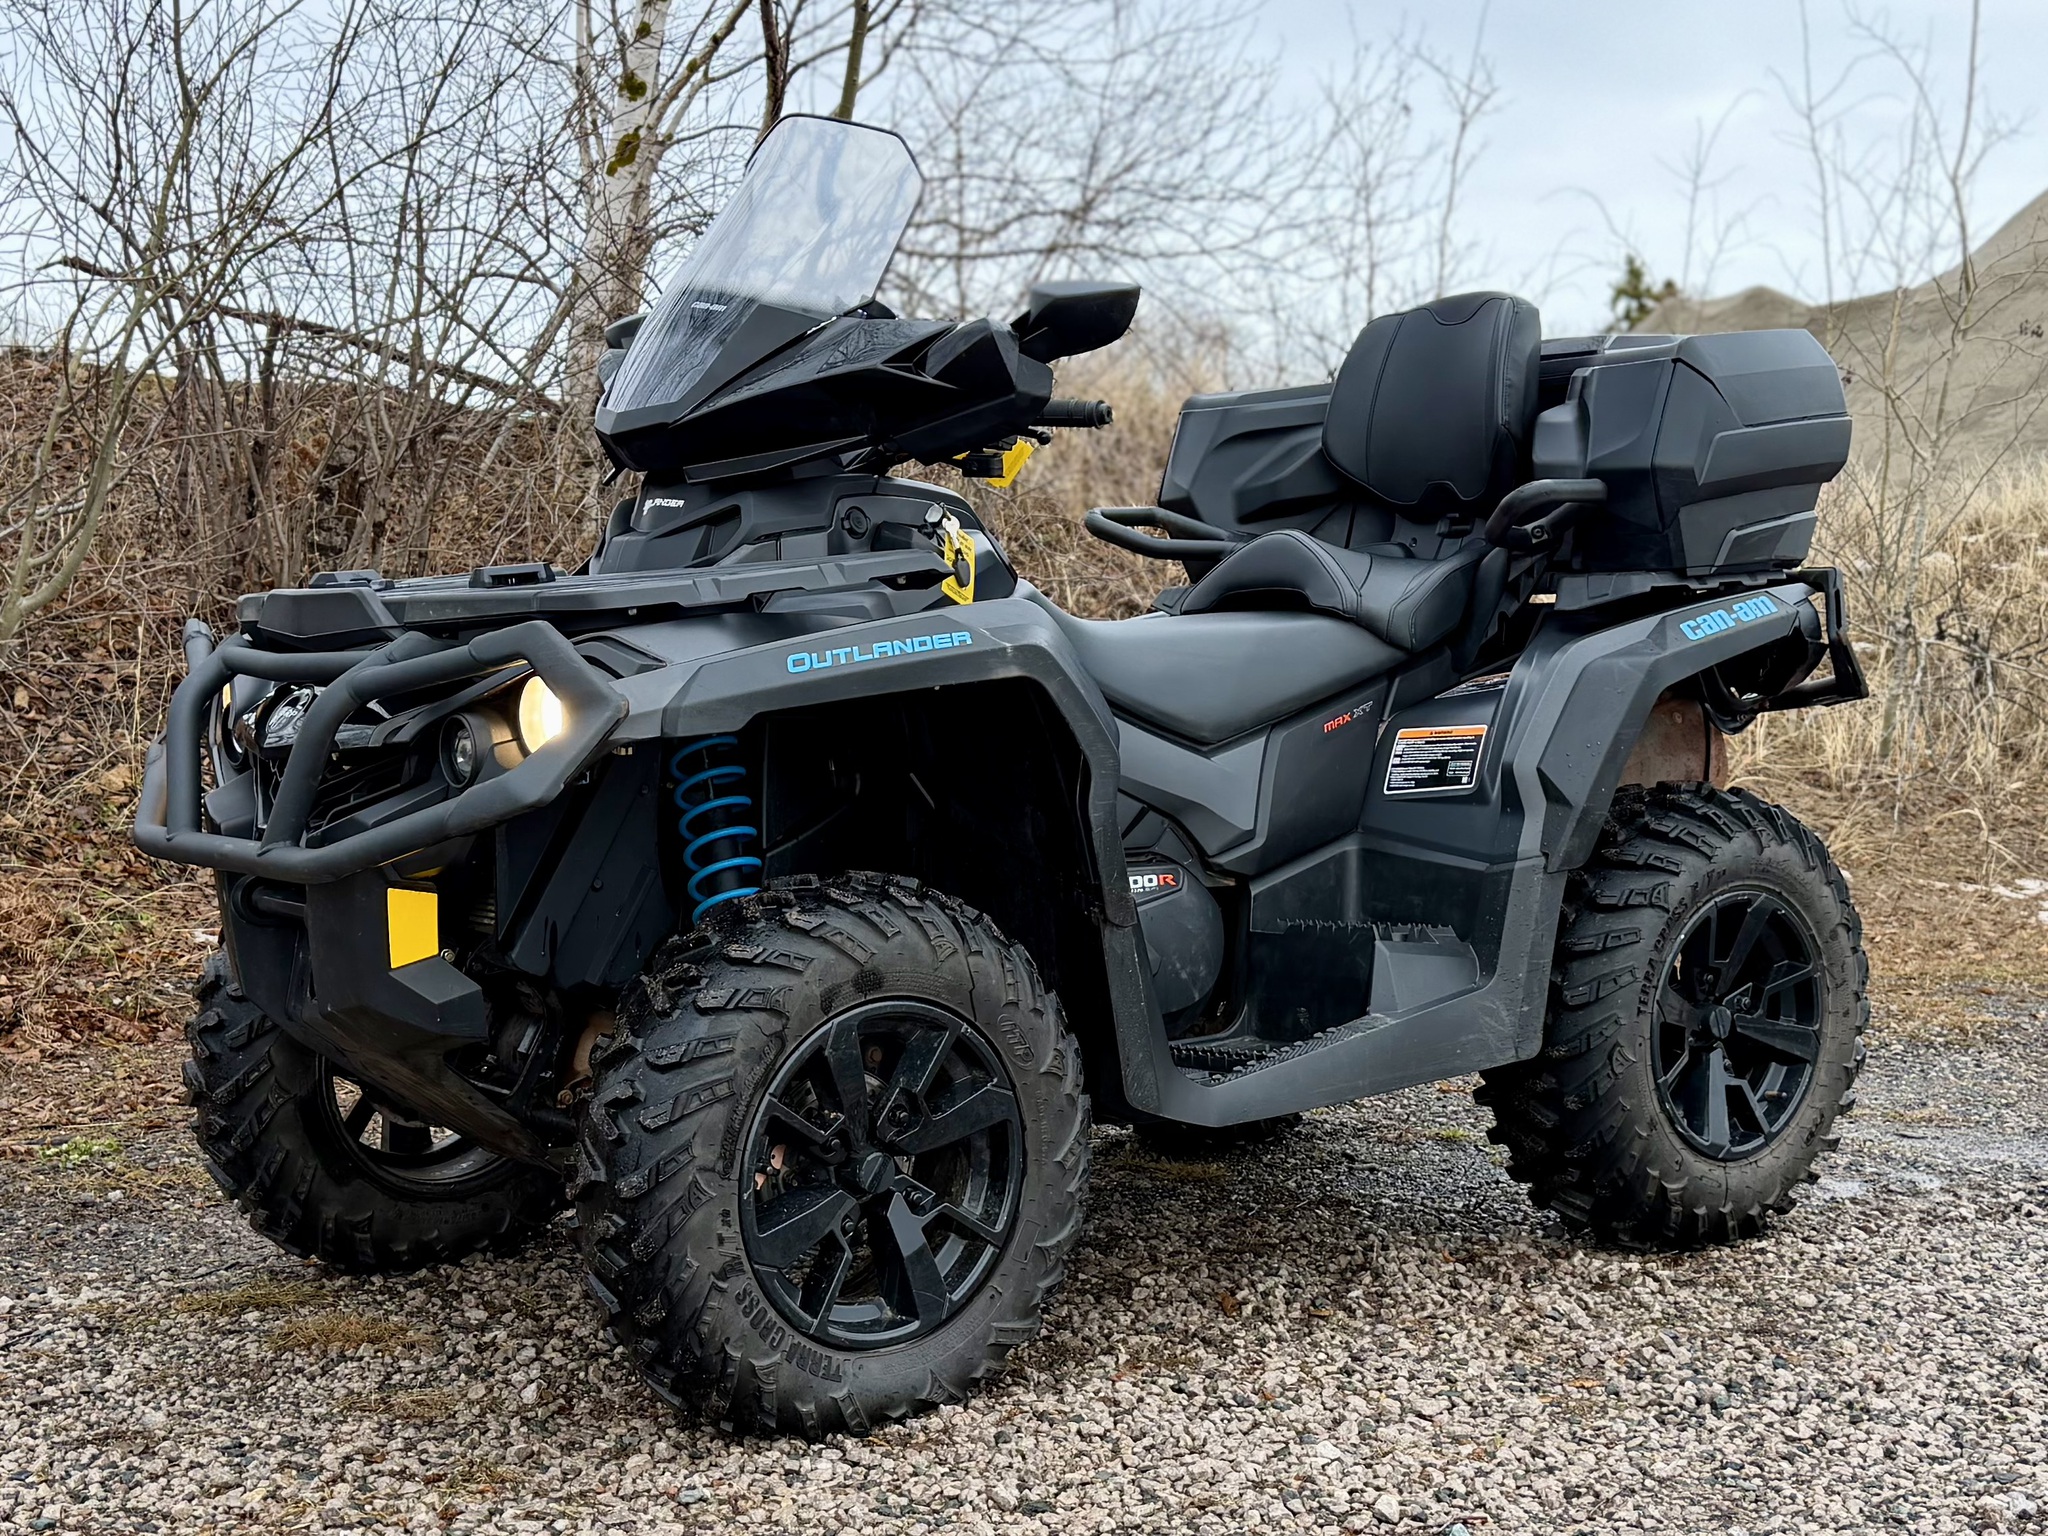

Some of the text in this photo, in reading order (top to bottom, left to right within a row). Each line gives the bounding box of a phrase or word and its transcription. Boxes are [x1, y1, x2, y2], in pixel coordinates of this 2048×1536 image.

[1679, 595, 1779, 641] can-am
[787, 631, 974, 674] OUTLANDER
[1323, 712, 1352, 733] MAX
[1128, 874, 1177, 889] 00R
[735, 1281, 786, 1350] CROSS
[785, 1341, 843, 1383] TERRA
